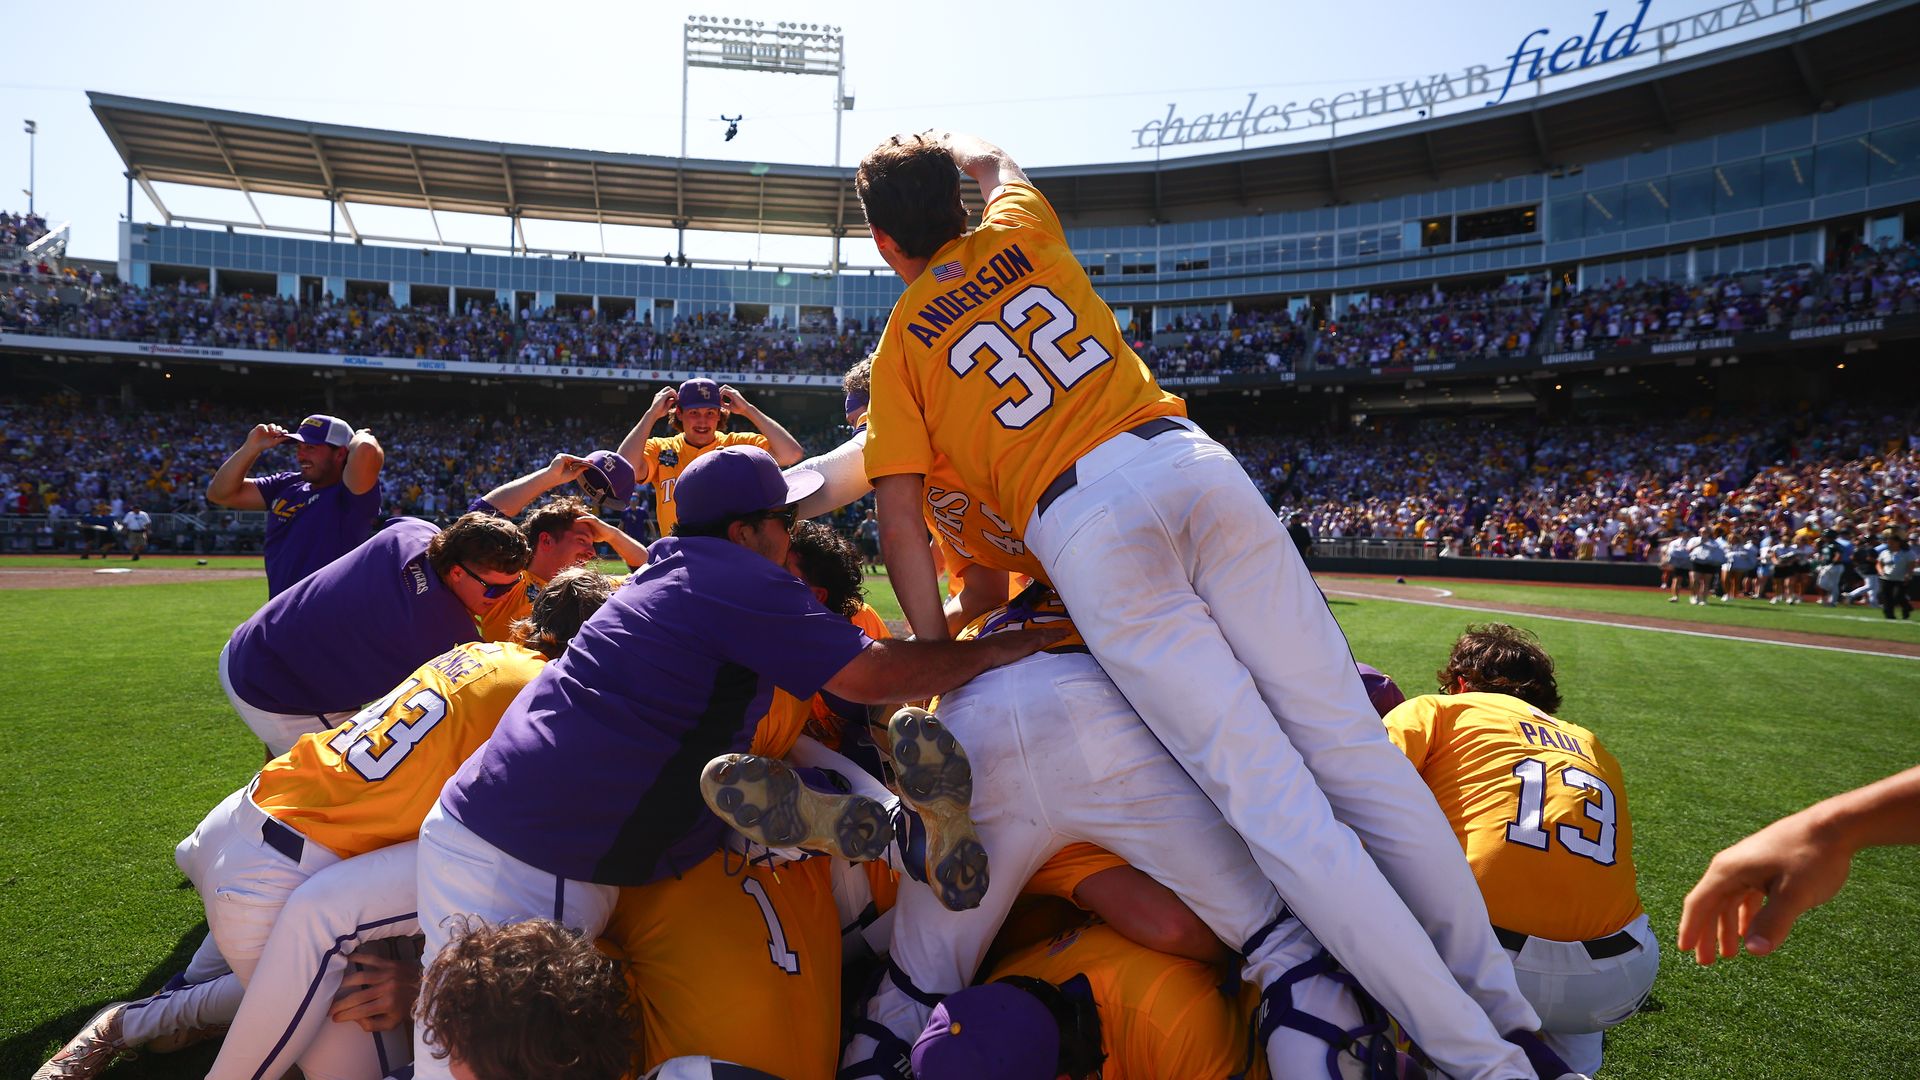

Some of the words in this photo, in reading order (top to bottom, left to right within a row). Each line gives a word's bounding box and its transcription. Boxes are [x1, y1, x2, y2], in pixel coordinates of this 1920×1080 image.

[1138, 93, 1297, 148] charles
[1307, 64, 1491, 127] SCHWAB
[1486, 0, 1651, 107] field
[907, 244, 1034, 348] ANDERSON
[1789, 324, 1842, 340] OREGON
[1844, 318, 1884, 334] STATE
[948, 284, 1114, 430] 32
[1699, 336, 1735, 350] STATE
[1185, 375, 1221, 385] CAROLINA
[409, 563, 429, 595] TIGERS
[326, 677, 448, 784] 43
[1519, 721, 1591, 761] PAUL
[1505, 757, 1617, 868] 13
